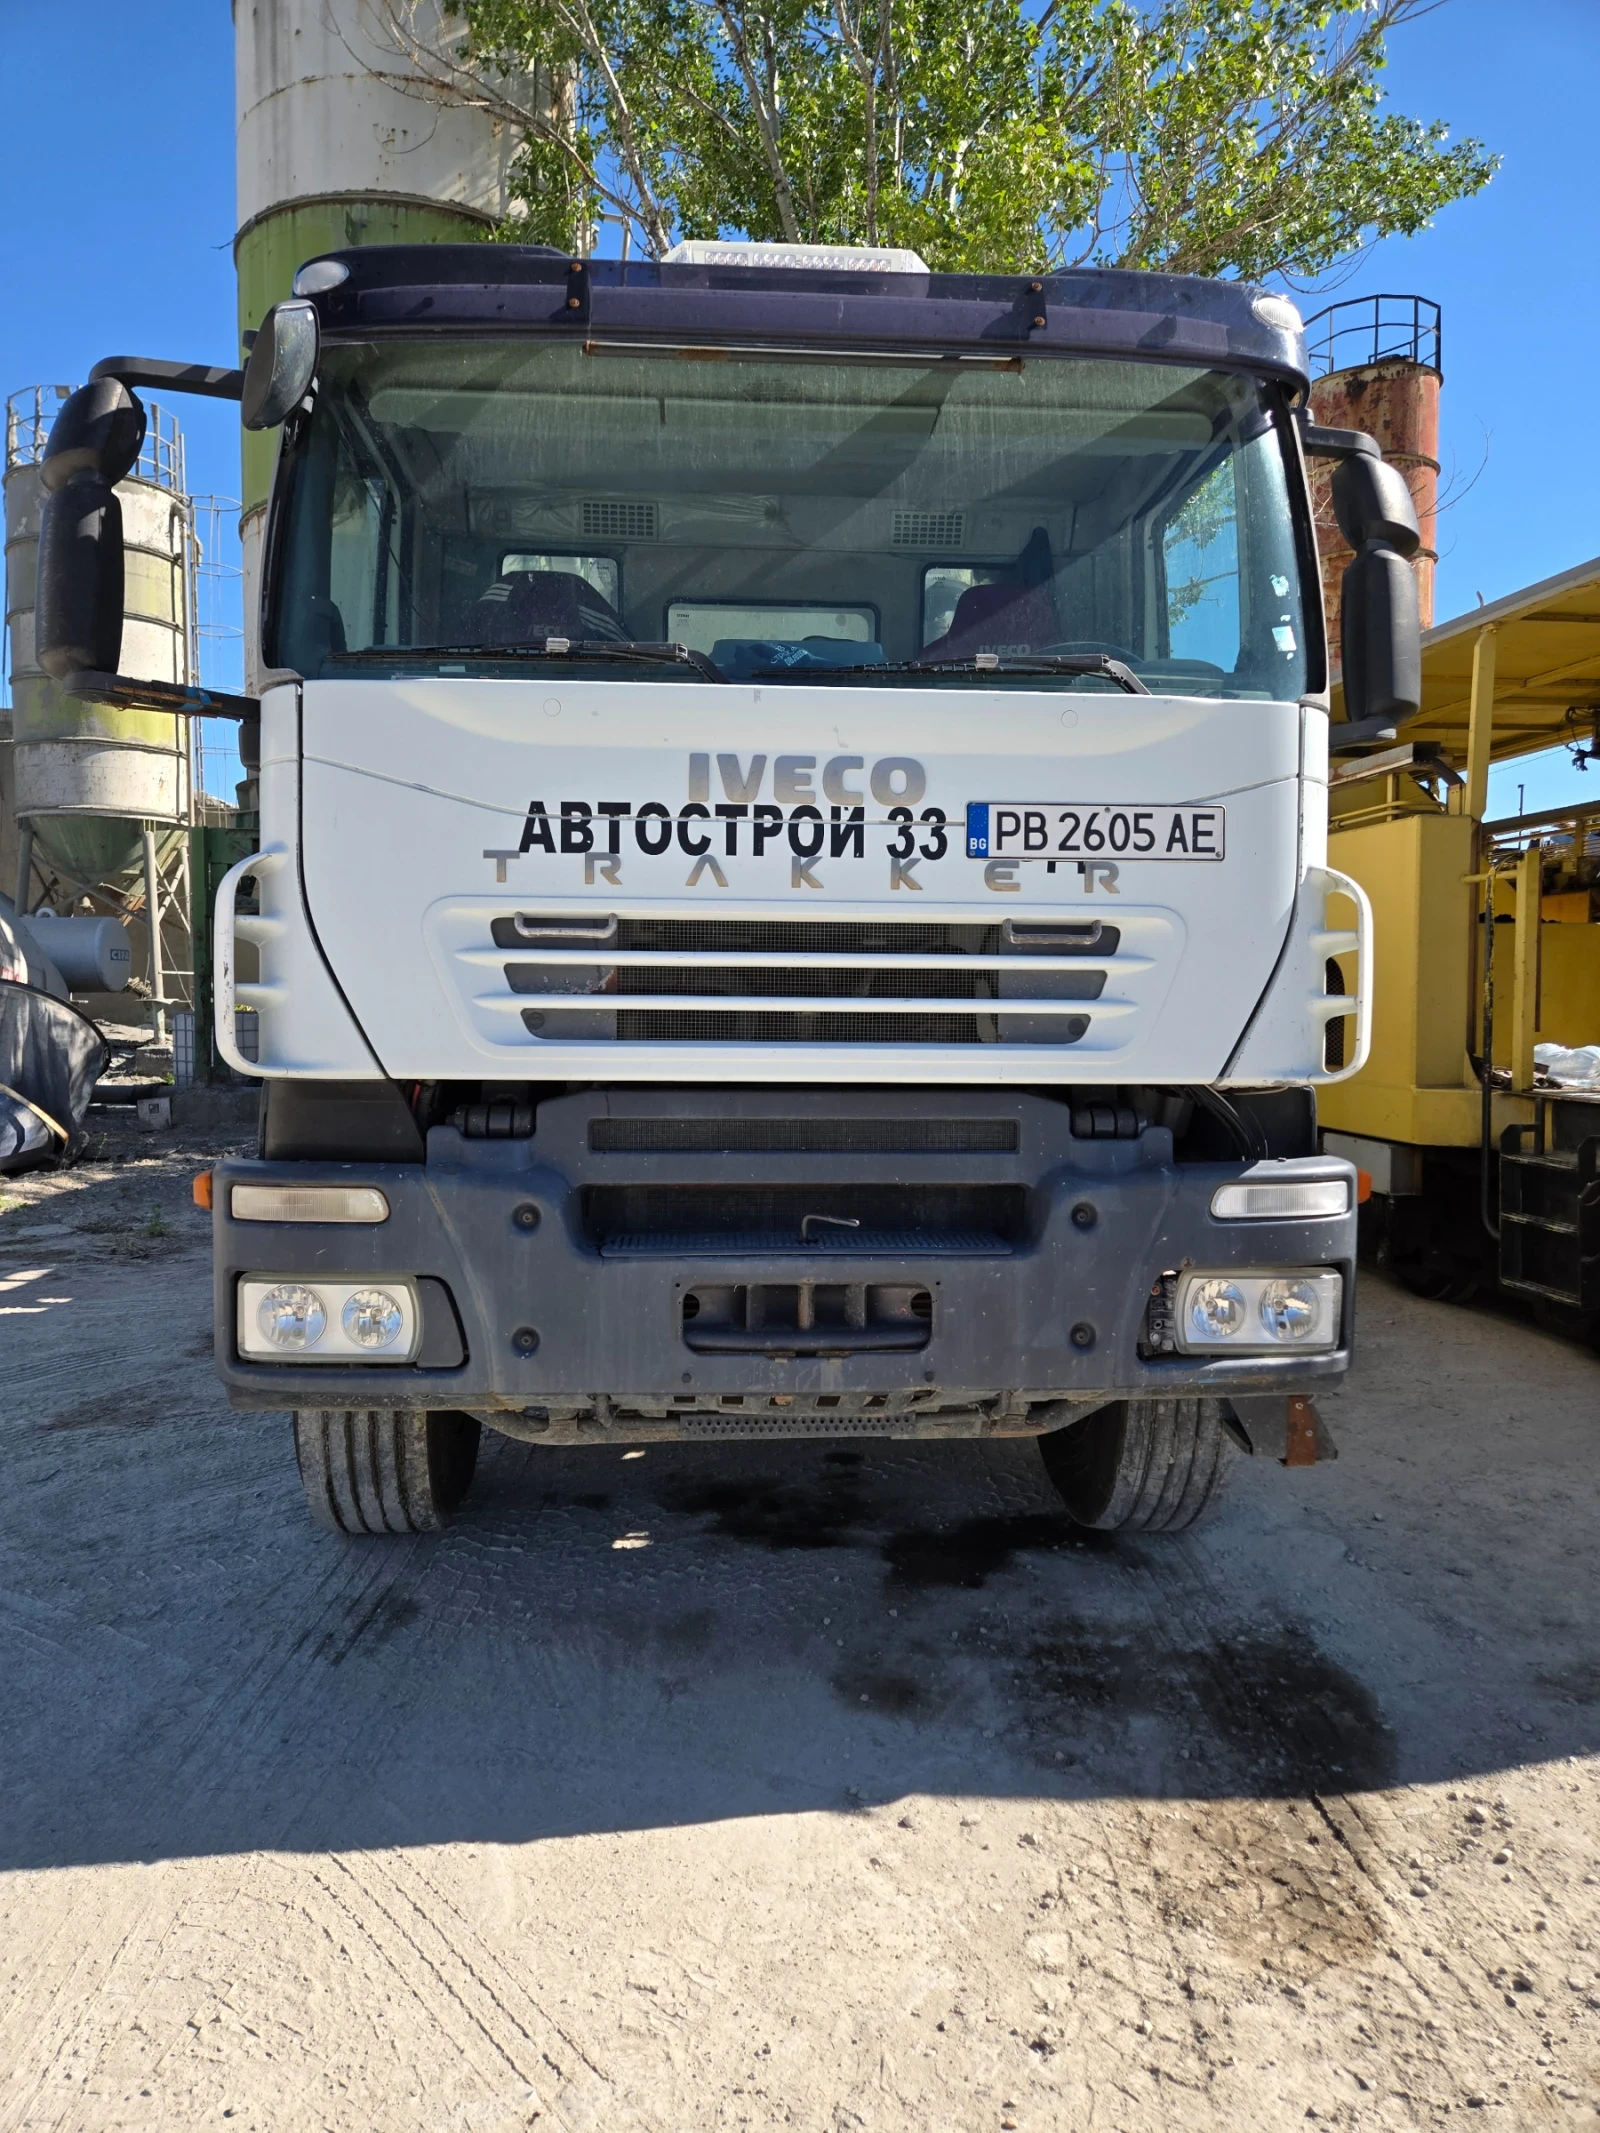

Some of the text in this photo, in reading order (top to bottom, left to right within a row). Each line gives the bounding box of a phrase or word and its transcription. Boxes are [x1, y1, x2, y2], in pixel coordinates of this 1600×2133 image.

[979, 644, 1031, 656] IVECO
[688, 752, 926, 806] IVECO
[518, 800, 948, 860] АВТОСТРОЙ 33
[969, 837, 987, 850] BG
[996, 811, 1216, 853] PB 2605 AE
[483, 850, 1120, 894] TRAKKER
